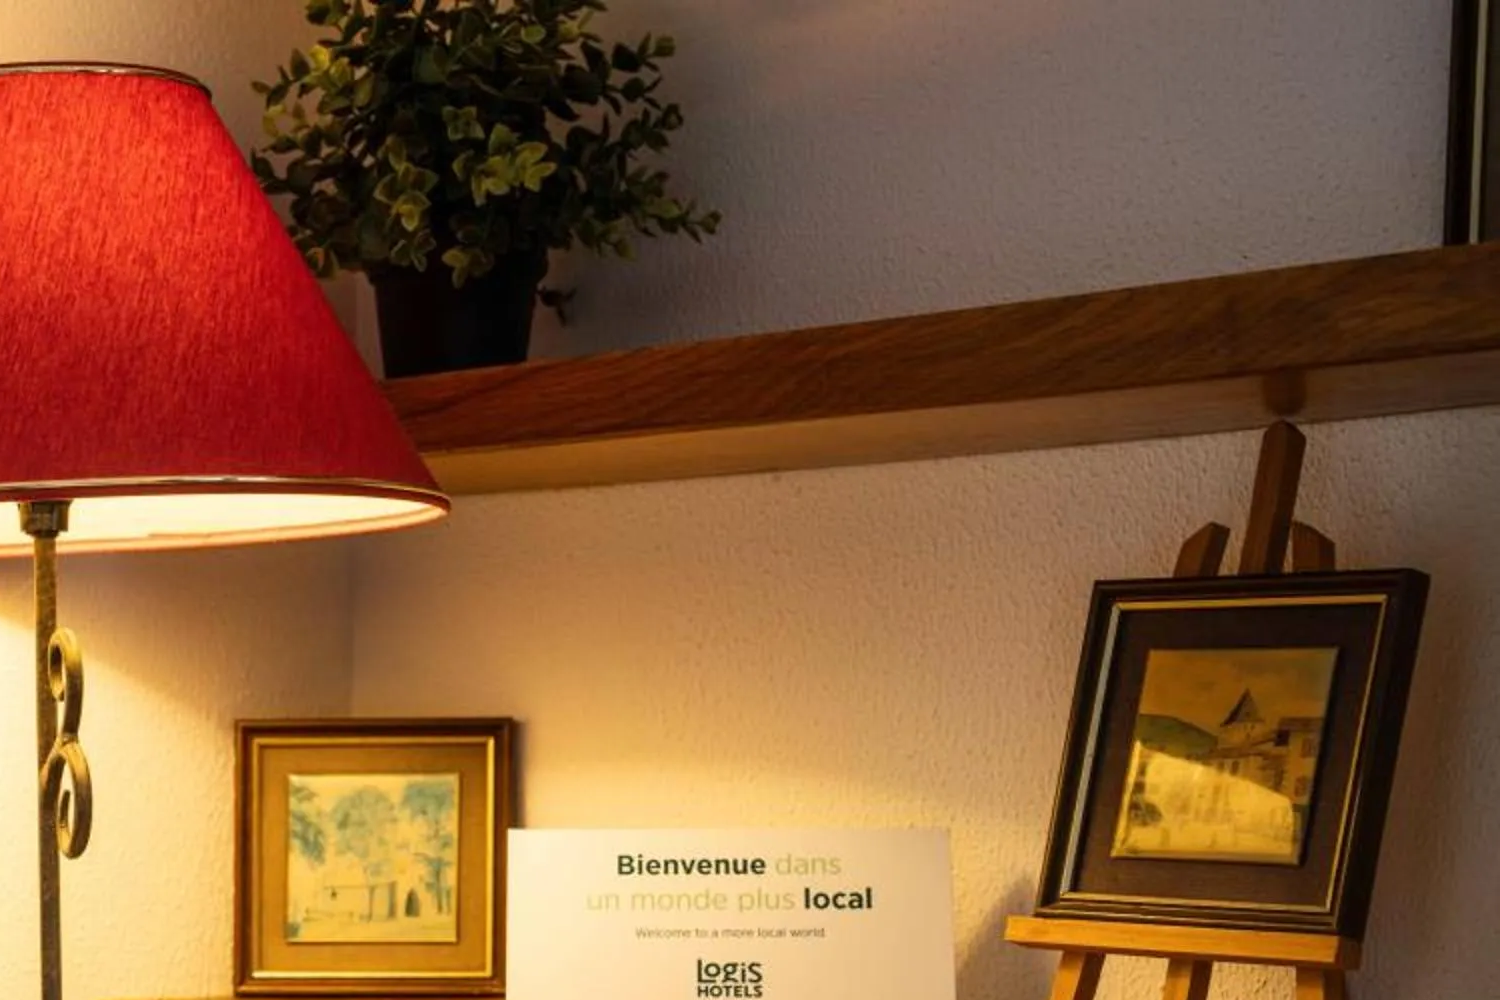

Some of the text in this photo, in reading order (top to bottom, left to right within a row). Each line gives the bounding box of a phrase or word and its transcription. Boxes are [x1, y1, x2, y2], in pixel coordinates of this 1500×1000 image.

[616, 854, 843, 875] Bienvenue dans
[587, 887, 874, 914] un monde plus local
[635, 927, 691, 939] Welcome
[695, 928, 708, 939] to
[721, 930, 753, 939] more
[757, 927, 787, 939] local
[697, 985, 763, 998] HOTELS
